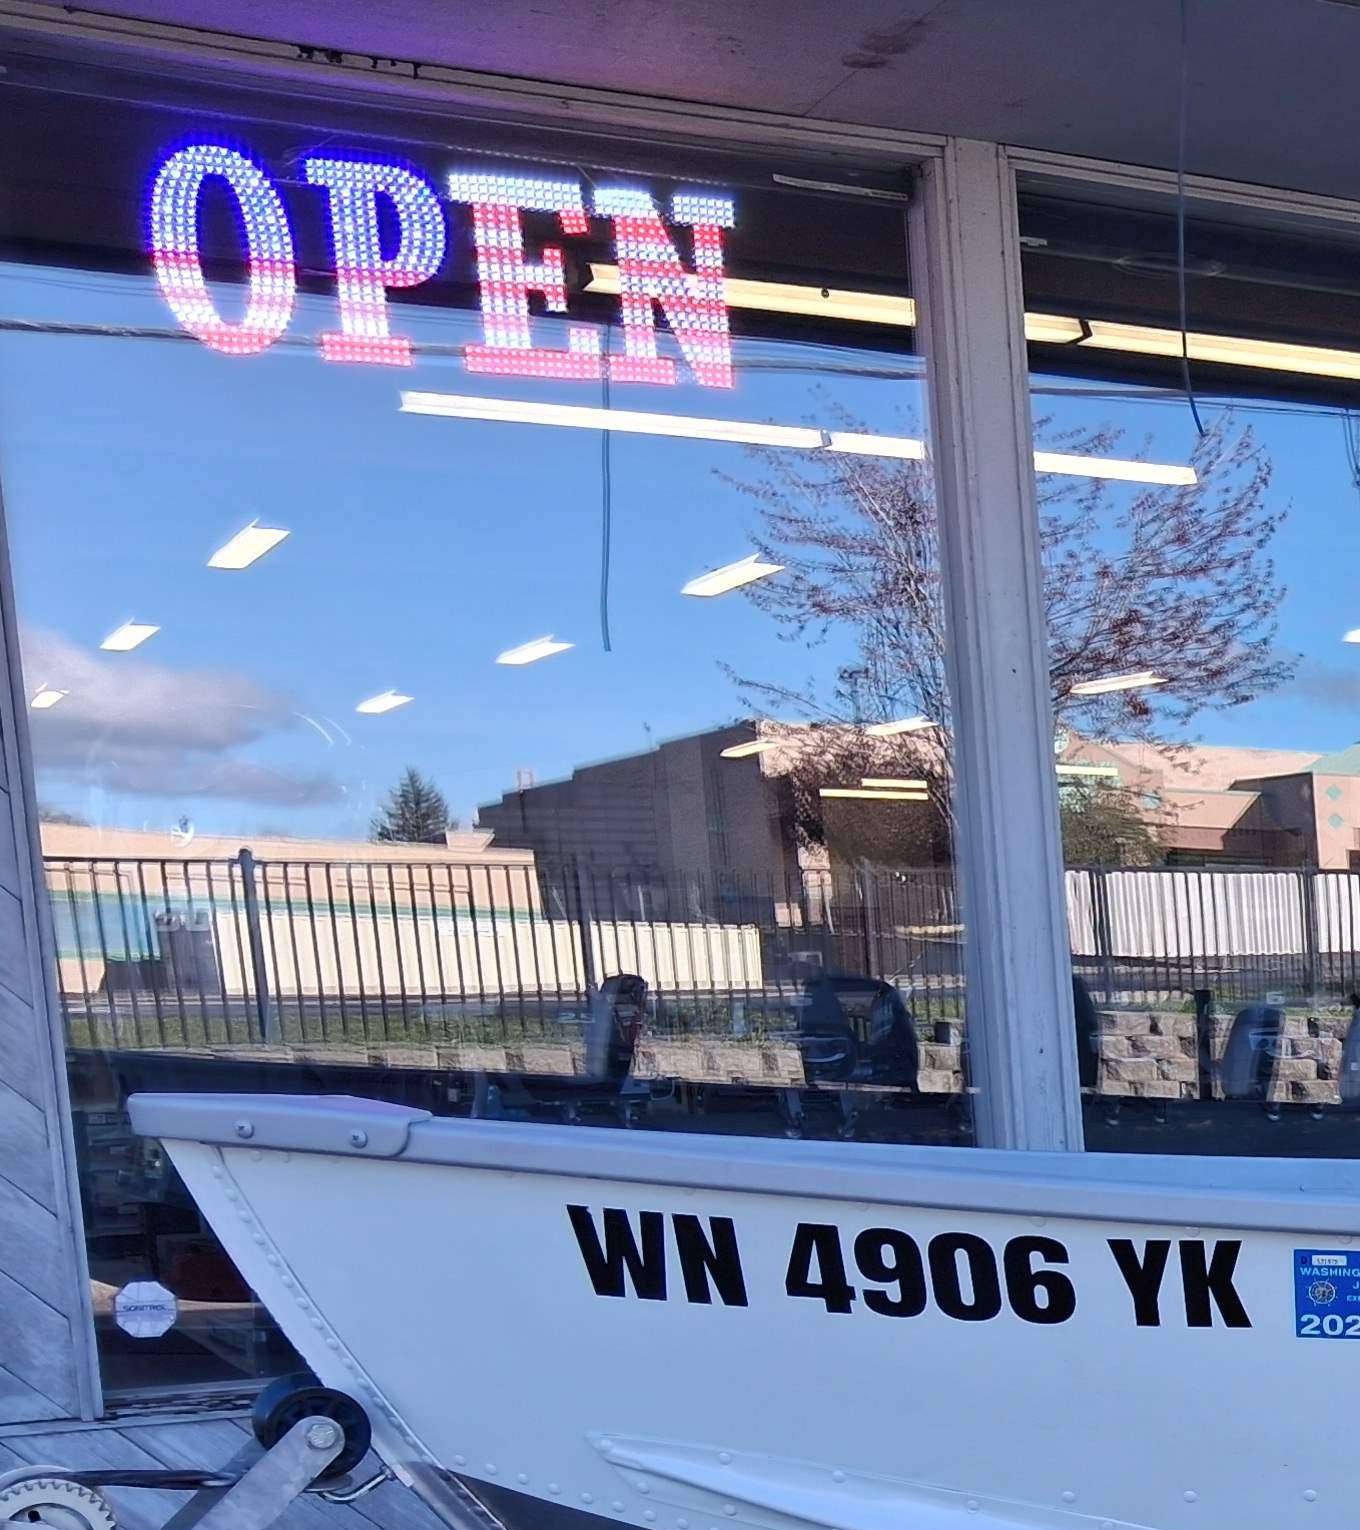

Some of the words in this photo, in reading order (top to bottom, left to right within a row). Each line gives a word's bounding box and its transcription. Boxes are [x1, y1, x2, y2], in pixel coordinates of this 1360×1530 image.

[150, 144, 736, 389] OPEN
[567, 1204, 748, 1306] WN
[785, 1222, 1077, 1325] 4906
[1107, 1239, 1252, 1328] YK
